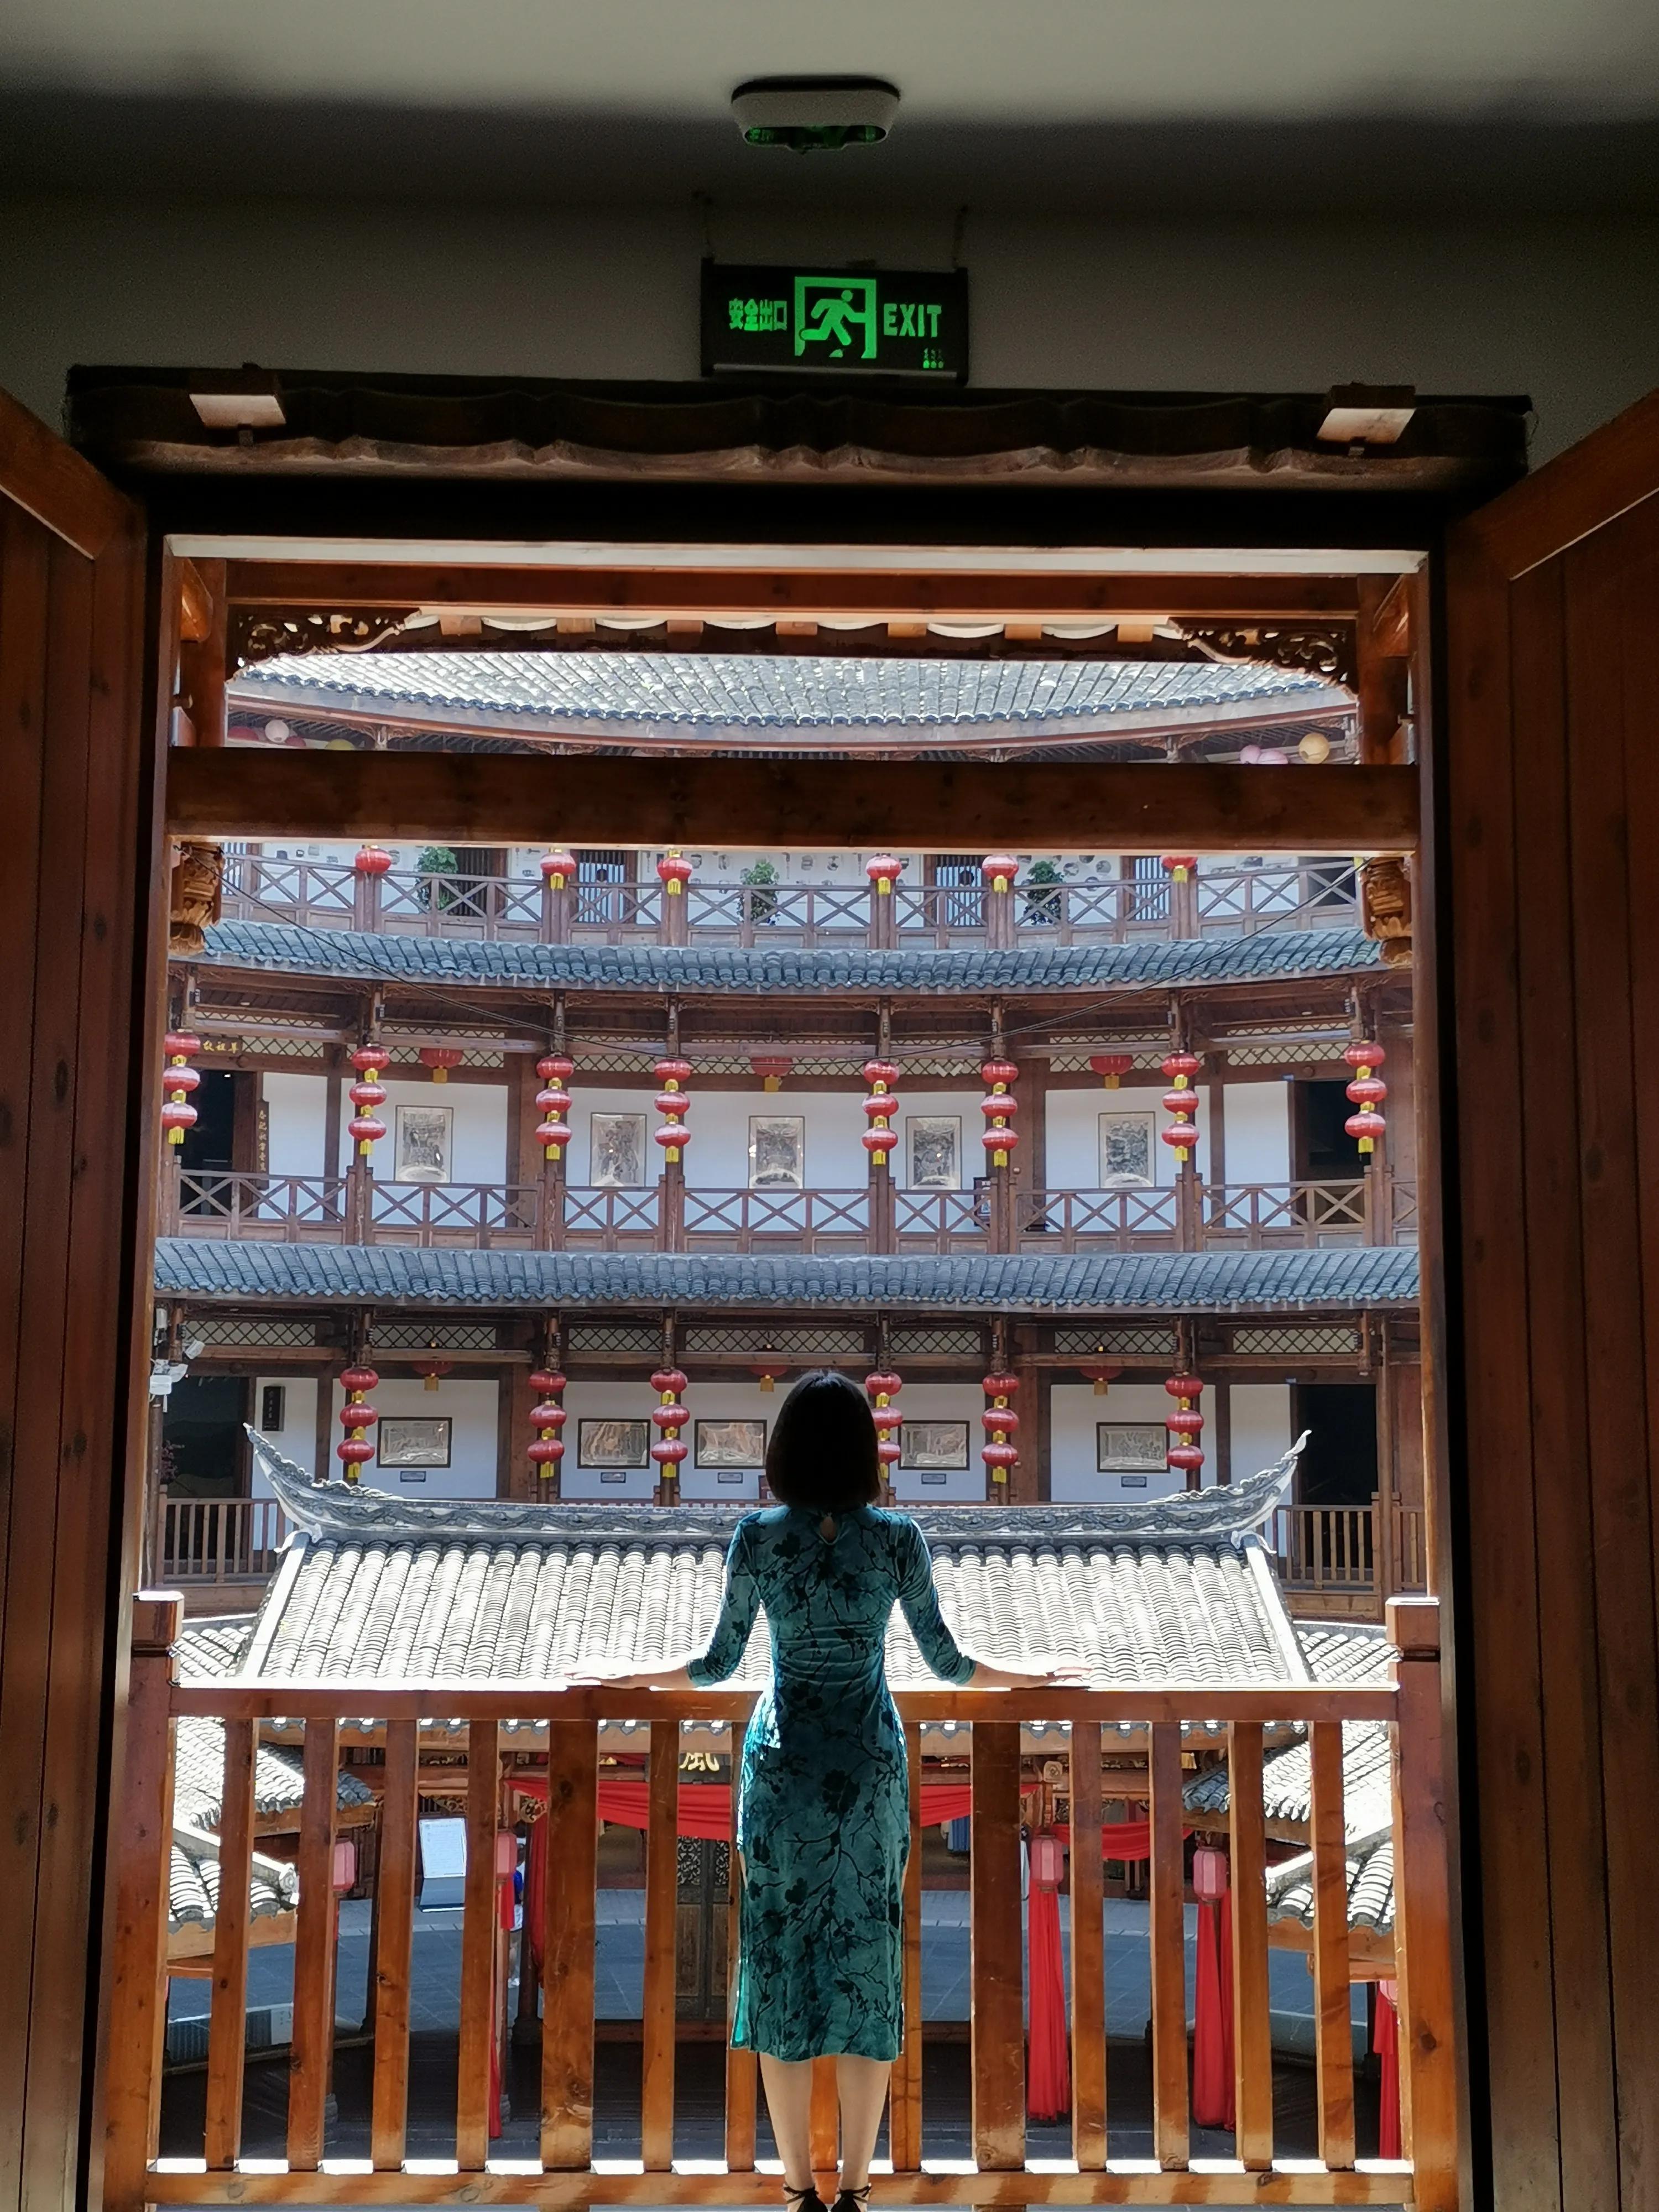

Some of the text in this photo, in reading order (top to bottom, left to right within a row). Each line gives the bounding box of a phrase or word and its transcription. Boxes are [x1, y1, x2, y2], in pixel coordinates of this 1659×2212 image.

[729, 298, 787, 331] 安全出口
[884, 304, 942, 337] EXIT
